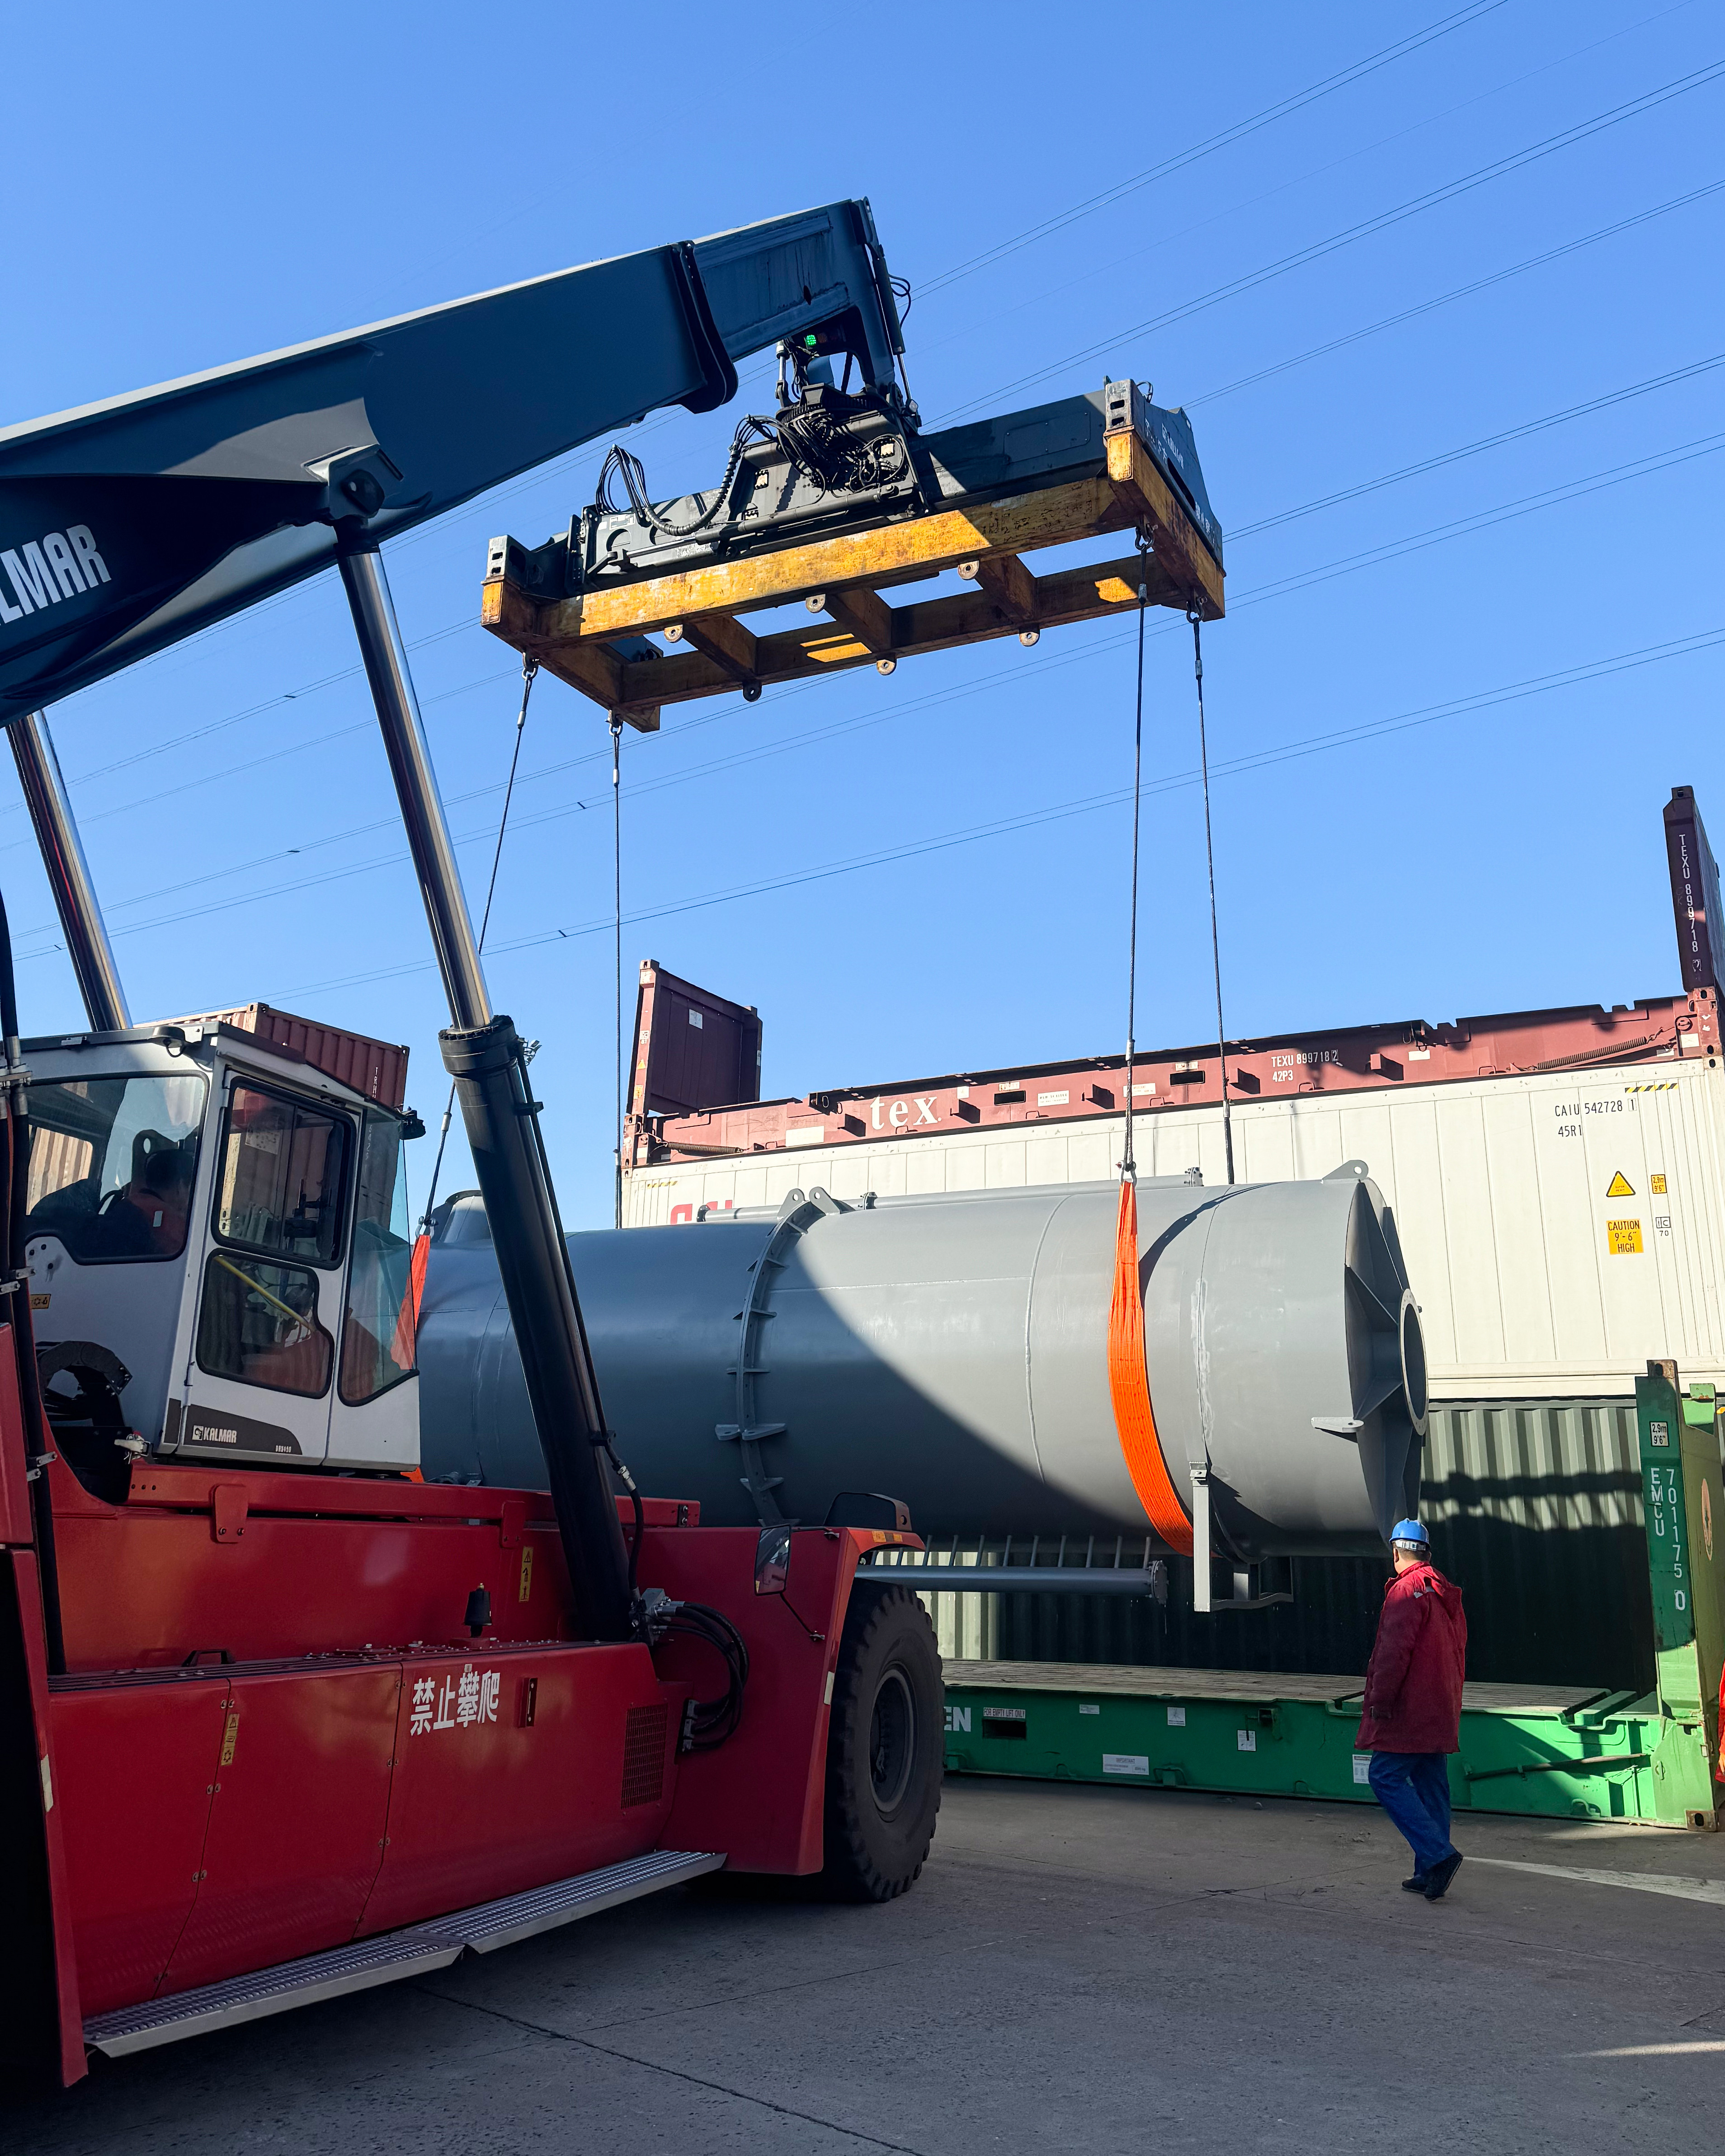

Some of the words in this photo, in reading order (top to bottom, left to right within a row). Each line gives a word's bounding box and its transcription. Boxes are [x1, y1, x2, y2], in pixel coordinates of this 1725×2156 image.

[0, 525, 112, 626] LMAR
[1679, 834, 1690, 879] TEXU
[1685, 884, 1698, 952] 899718
[1271, 1054, 1294, 1067] TEXU
[1296, 1051, 1329, 1064] 899718
[1273, 1070, 1293, 1082] 42P3
[1555, 1103, 1579, 1116] CAIU
[1585, 1100, 1622, 1114] 542728
[1558, 1125, 1582, 1137] 45R1
[1608, 1220, 1640, 1231] CAUTION
[1617, 1243, 1635, 1252] HIGH
[203, 1427, 237, 1443] KALMAR
[1652, 1424, 1667, 1434] 2,9m
[1651, 1468, 1664, 1536] EMCU
[1666, 1469, 1682, 1578] 701175
[410, 1669, 500, 1736] 禁止攀爬
